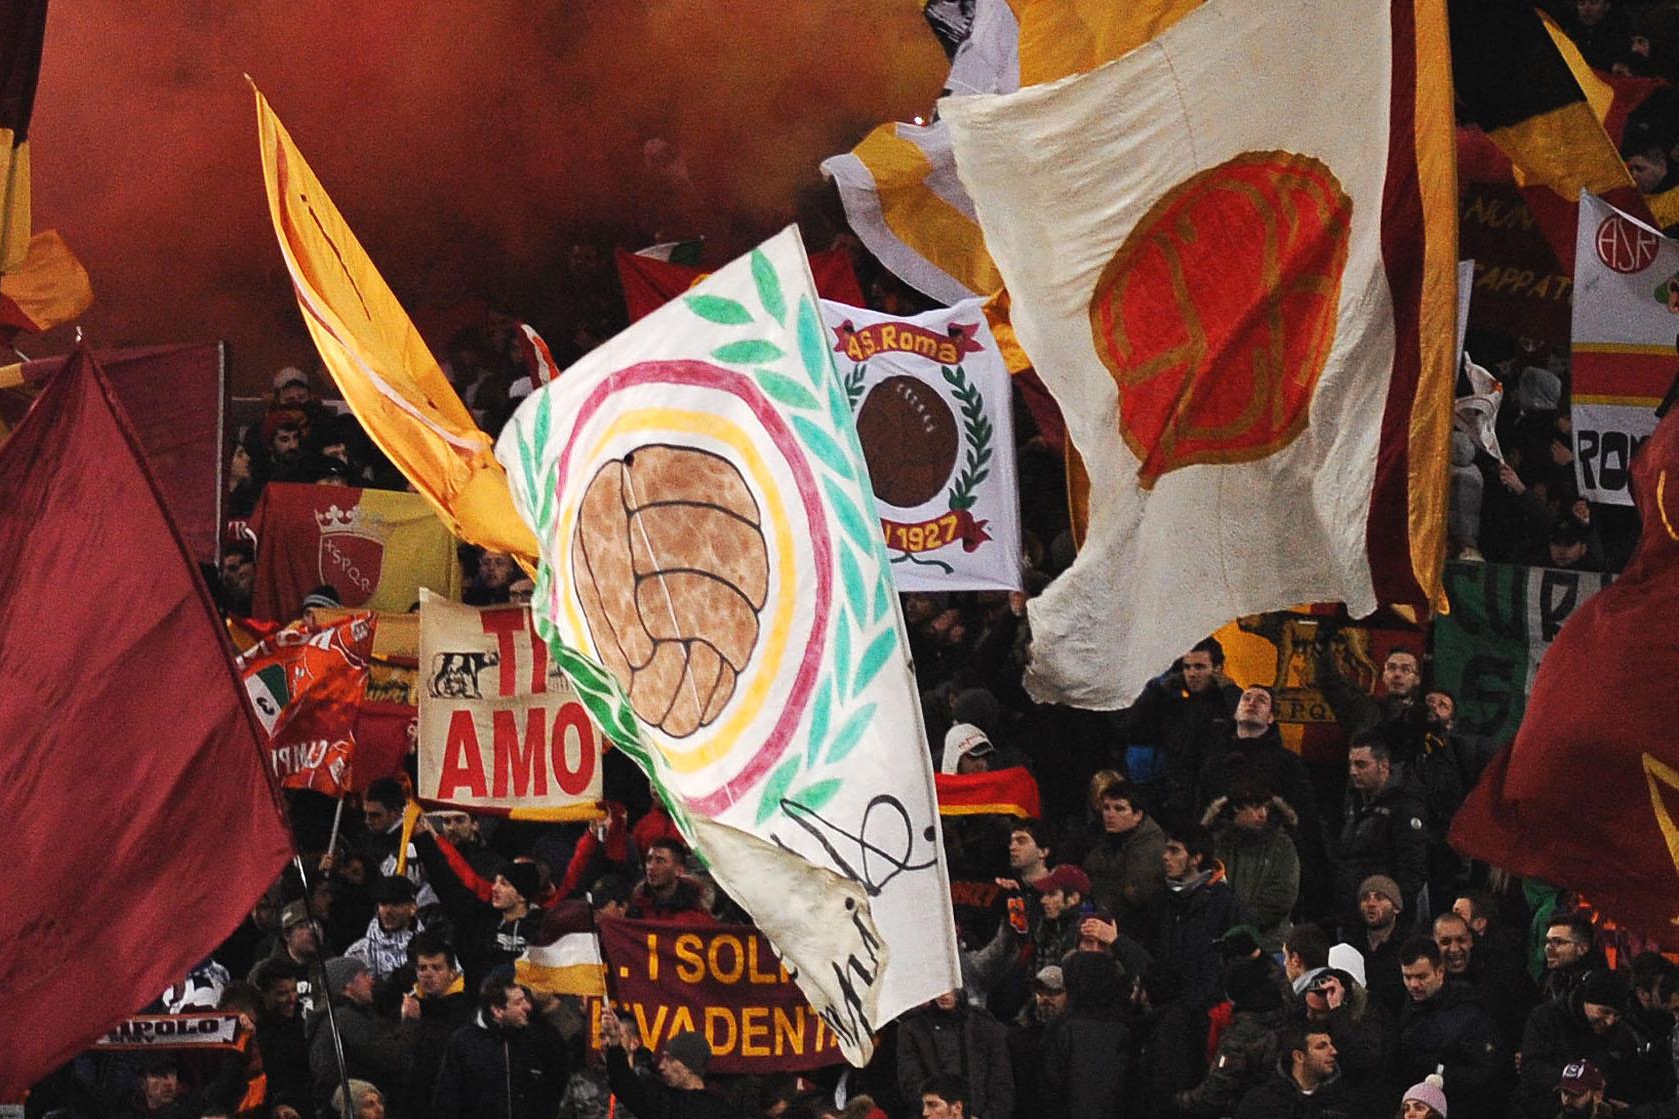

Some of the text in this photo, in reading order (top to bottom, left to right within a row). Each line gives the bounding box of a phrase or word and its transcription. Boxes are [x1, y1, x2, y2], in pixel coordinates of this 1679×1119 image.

[1577, 431, 1640, 491] RO
[480, 606, 547, 697] TI
[437, 702, 596, 799] AMO
[673, 932, 791, 985] SOL
